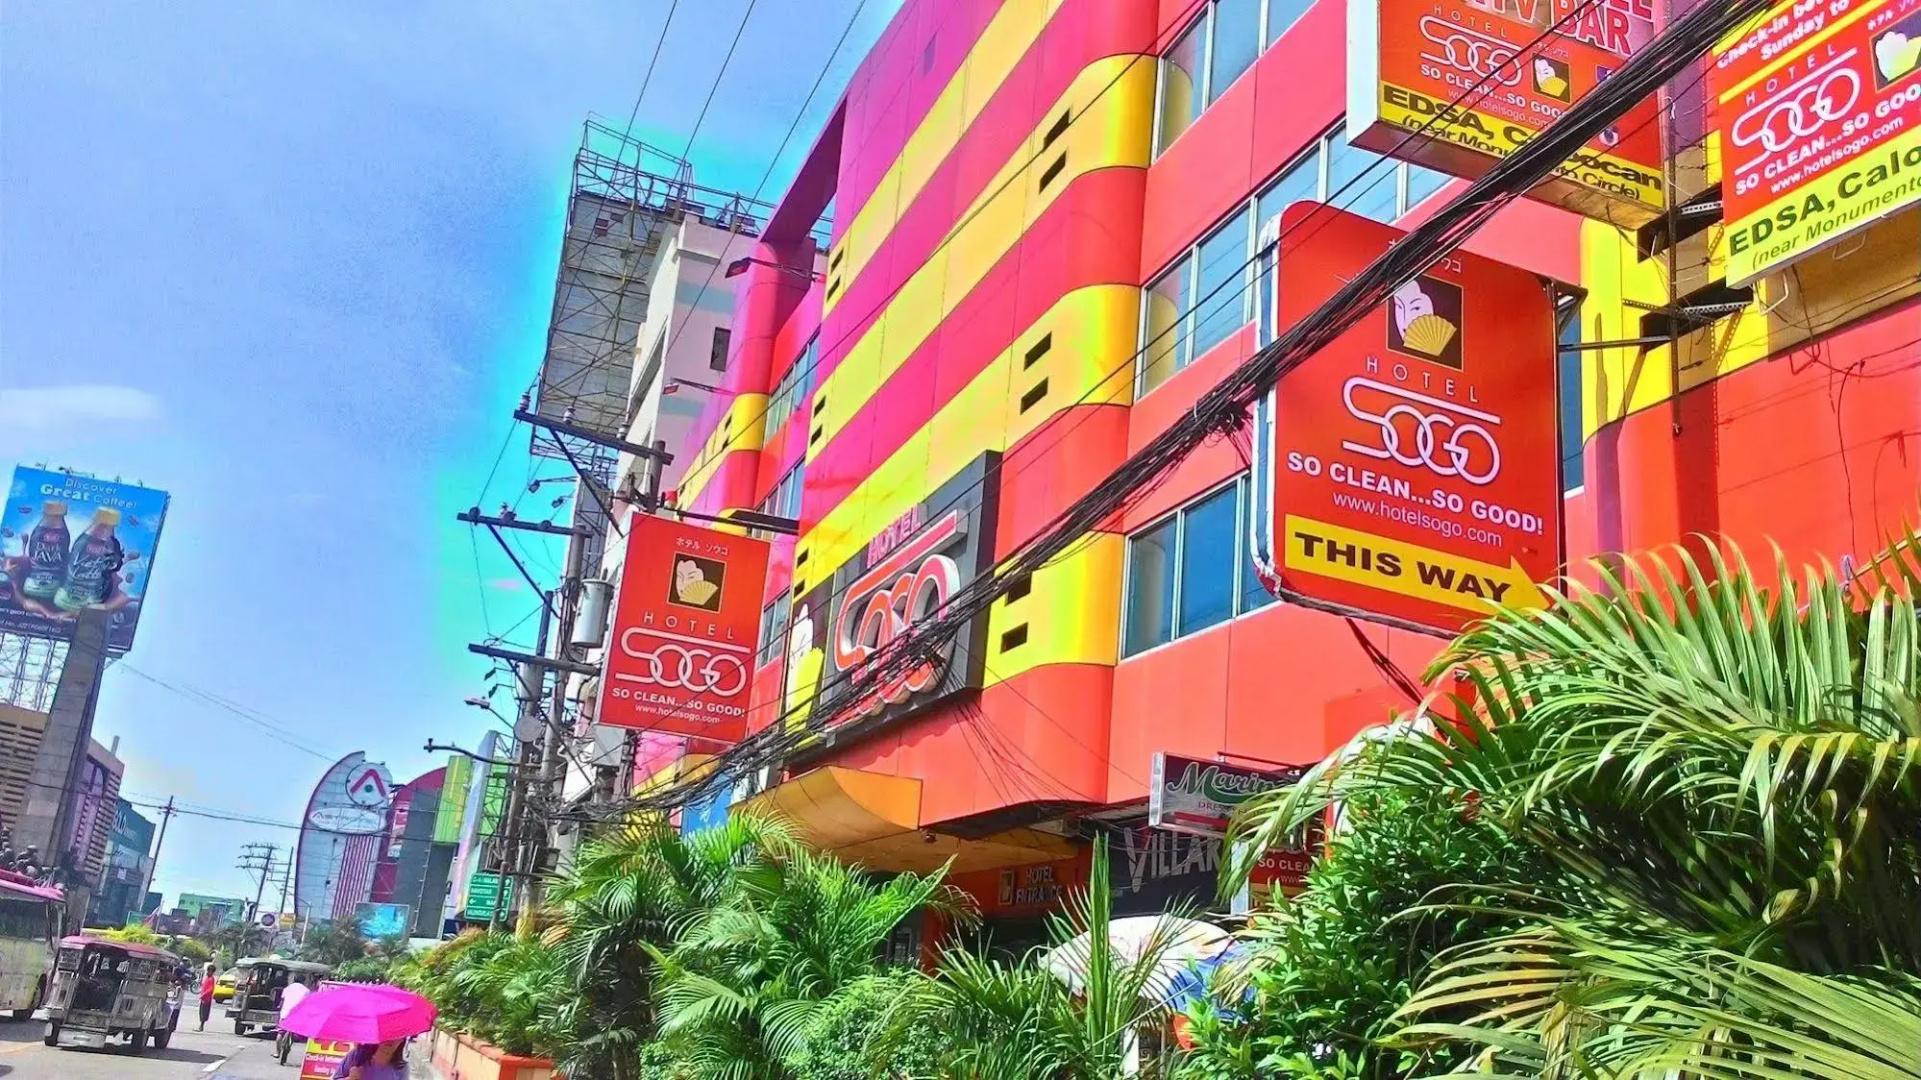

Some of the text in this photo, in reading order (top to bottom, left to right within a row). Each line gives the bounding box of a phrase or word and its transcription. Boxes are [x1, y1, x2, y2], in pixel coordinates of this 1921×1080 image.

[1433, 4, 1507, 38] HOTEL
[1552, 0, 1633, 57] BAR
[1761, 11, 1825, 61] Sunday
[1419, 15, 1522, 86] SOGO
[1421, 64, 1441, 80] SO
[1745, 44, 1836, 107] HOTEL
[1384, 84, 1494, 140] EDSA,
[1731, 47, 1861, 176] SOGO
[1770, 116, 1903, 195] www.hotelsogo.com
[1583, 172, 1640, 200] Circle)
[1735, 173, 1759, 196] SO
[1752, 234, 1800, 271] (near
[1366, 356, 1479, 403] HOTEL
[1342, 376, 1501, 485] SOGO
[40, 483, 137, 509] Great Coffee!
[65, 478, 118, 495] Discover
[1287, 452, 1544, 536] SO CLEAN...SO GOOD!
[866, 502, 921, 569] HOTEL
[1332, 492, 1502, 548] www.hotelsogo.com
[34, 550, 63, 562] JAVA
[1295, 531, 1511, 602] THIS WAY
[643, 611, 734, 640] HOTEL
[614, 626, 751, 697] SOGO
[612, 687, 630, 699] SO
[706, 702, 746, 718] GOOD!
[635, 703, 721, 724] www.hotelsogo.com
[1025, 865, 1054, 885] HOTEL
[1258, 858, 1275, 868] SO
